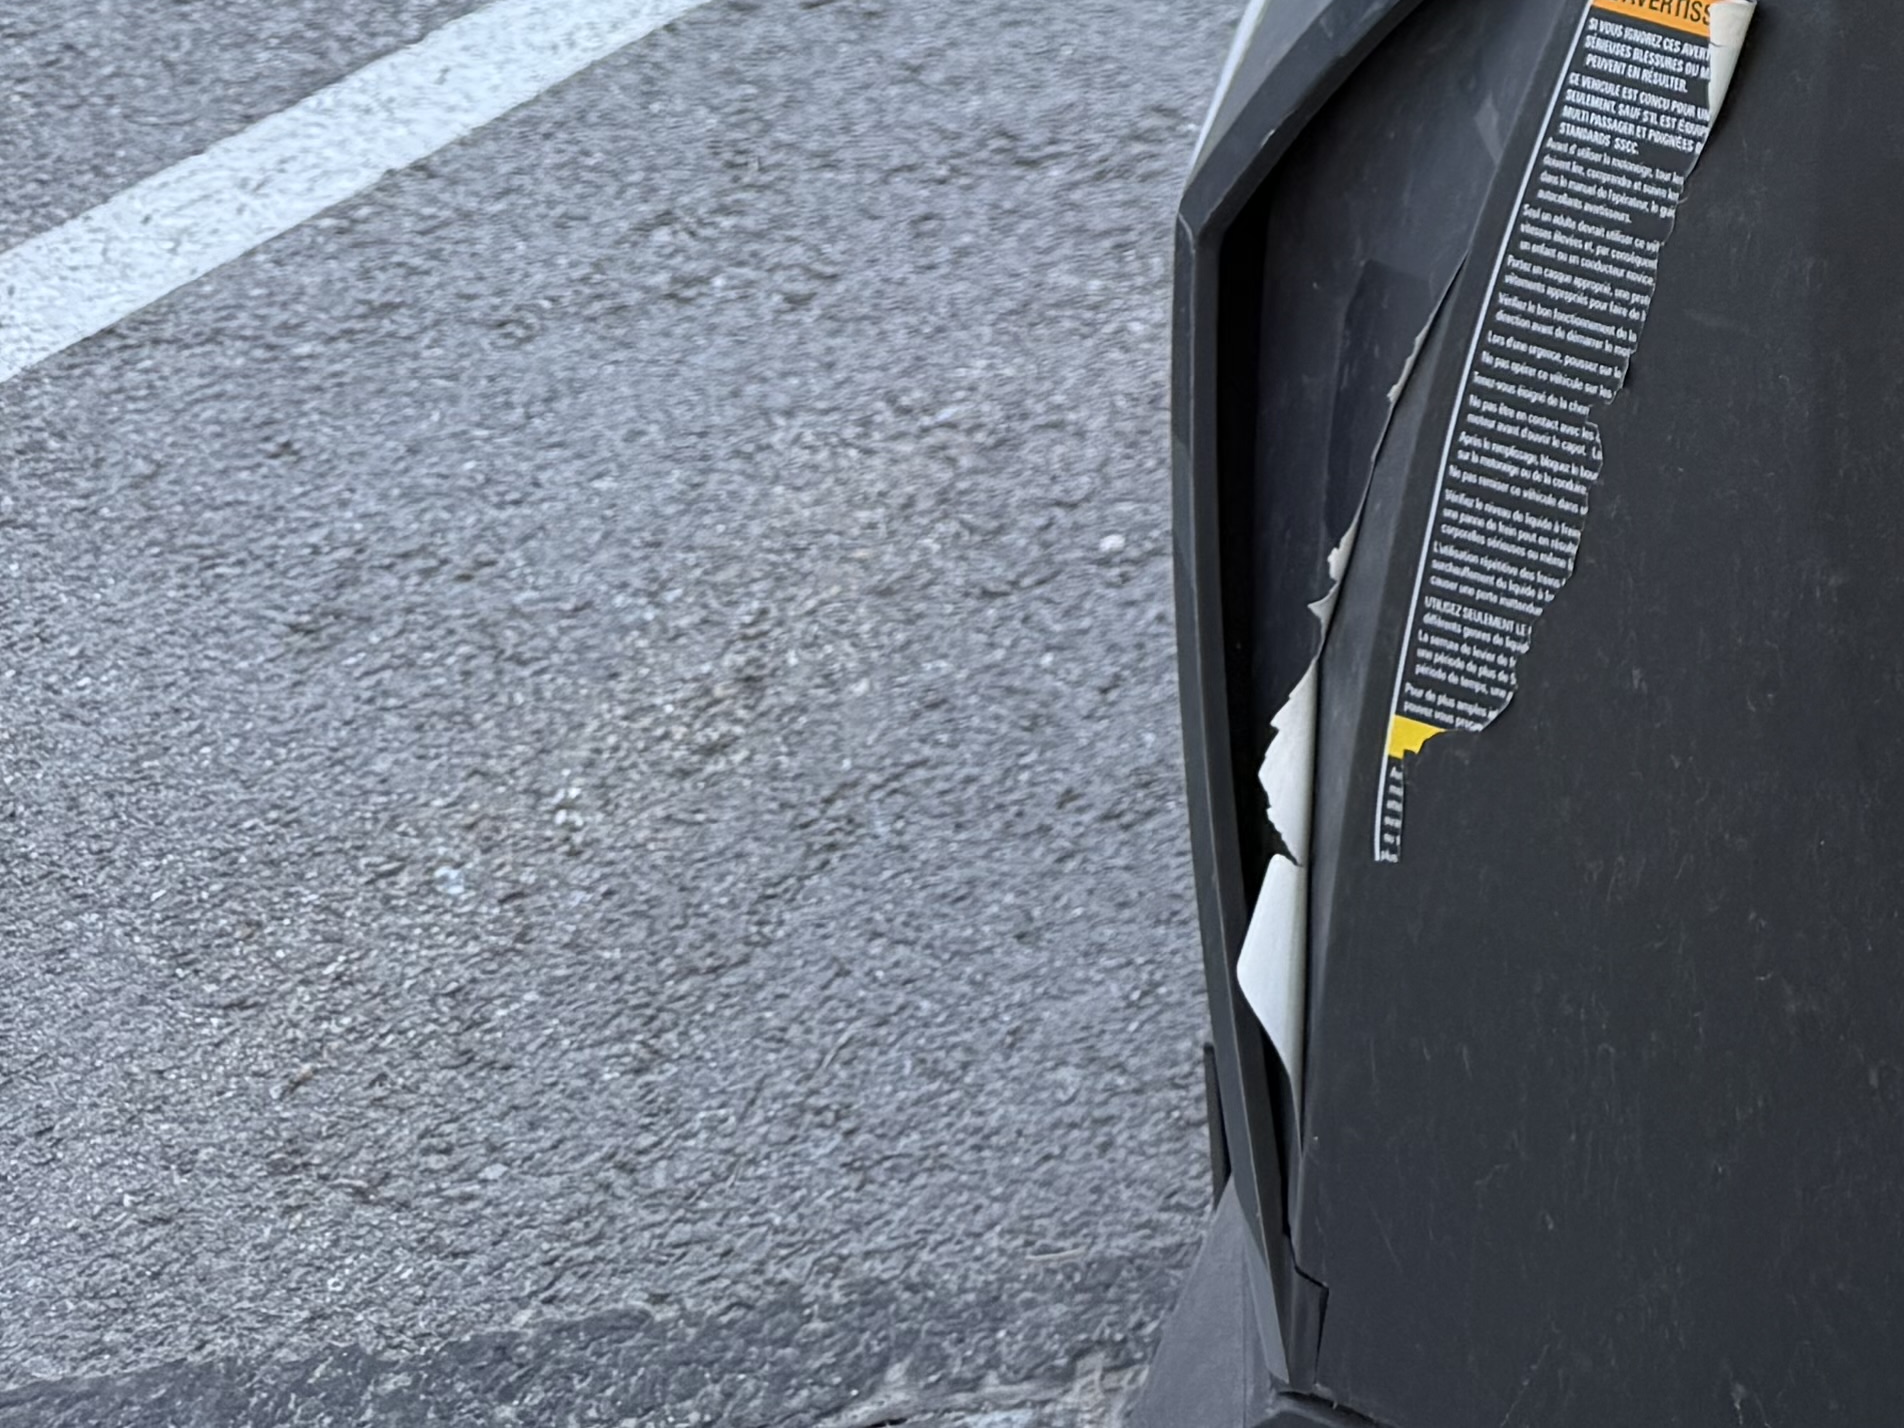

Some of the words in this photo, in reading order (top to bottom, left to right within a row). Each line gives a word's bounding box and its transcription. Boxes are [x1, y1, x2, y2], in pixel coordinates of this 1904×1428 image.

[1599, 20, 1622, 37] VOUS
[1662, 37, 1680, 52] CES
[1585, 53, 1625, 74] PEUVENT
[1626, 64, 1640, 79] EN
[1621, 86, 1638, 100] EST
[1670, 100, 1695, 116] POUR
[1635, 125, 1646, 138] ET
[1659, 114, 1676, 128] EST
